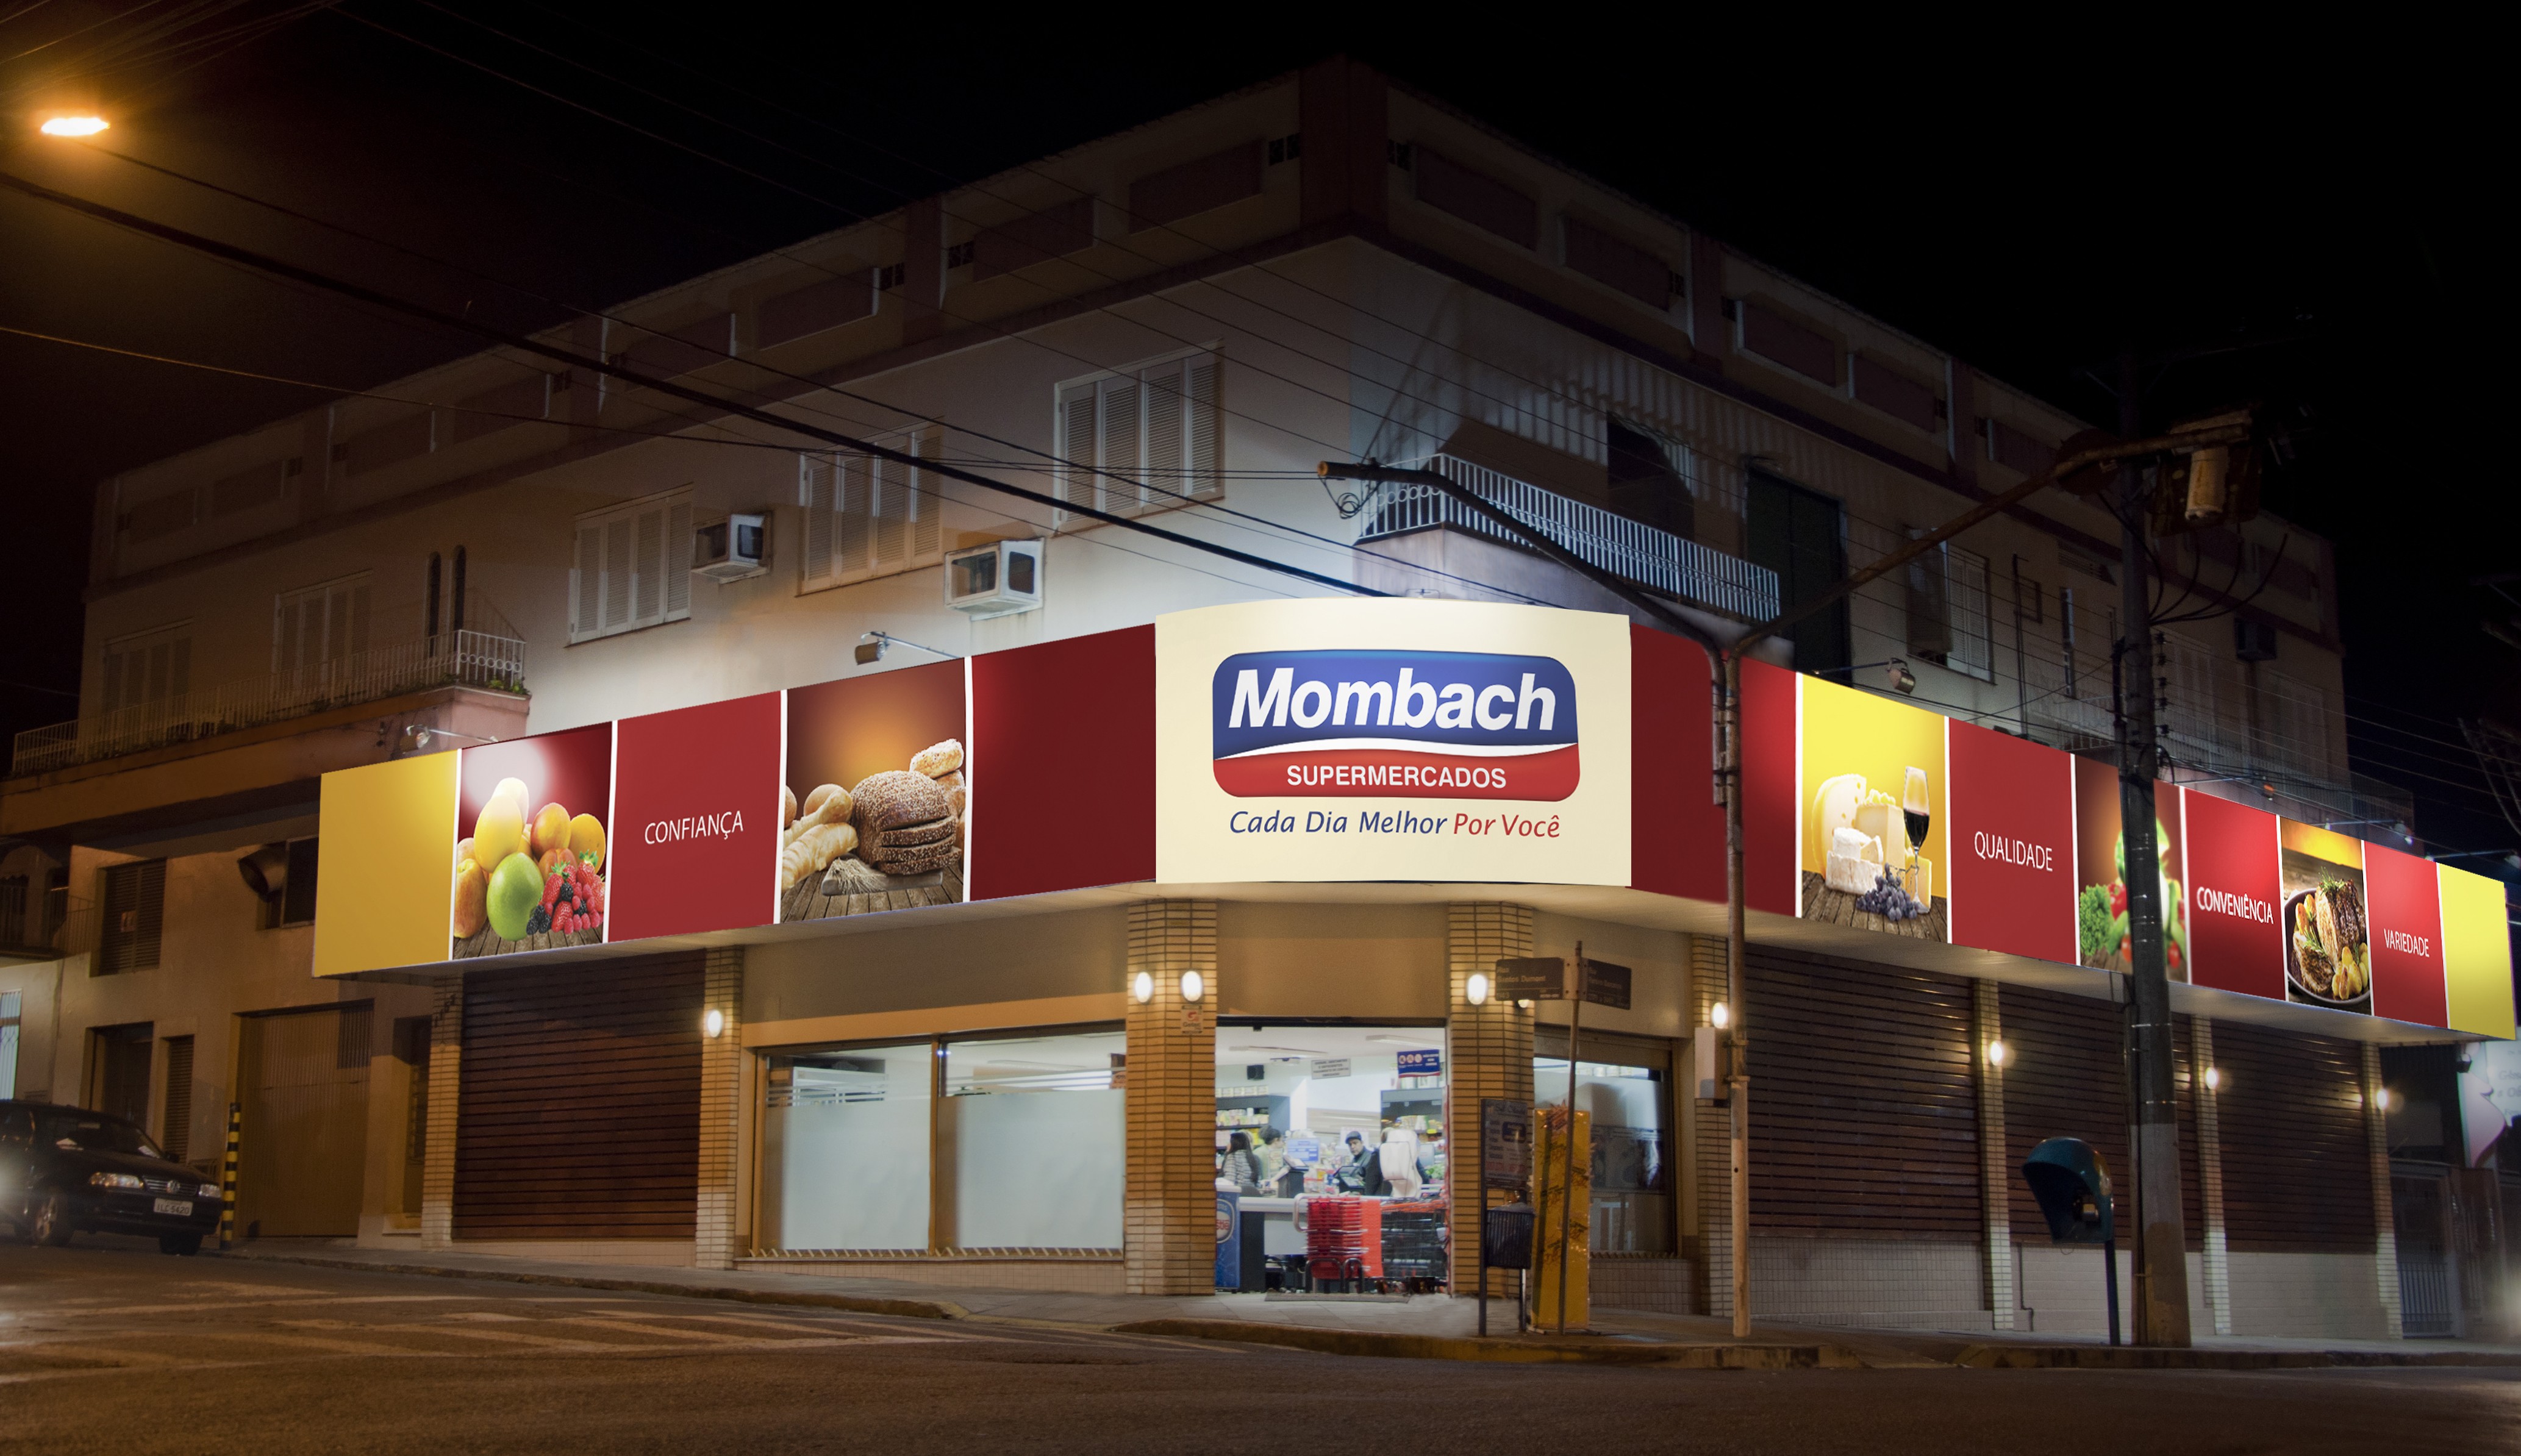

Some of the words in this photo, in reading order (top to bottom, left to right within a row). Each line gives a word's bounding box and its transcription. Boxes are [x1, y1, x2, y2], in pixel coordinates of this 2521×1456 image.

[1228, 668, 1556, 731] Mombach
[1287, 765, 1506, 789] SUPERMERCADOS
[645, 810, 744, 844] CONFIANÇA
[1230, 810, 1295, 833] Cada
[1305, 811, 1348, 833] Dia
[1359, 811, 1448, 834] Melhor
[1454, 813, 1498, 836] Por
[1501, 815, 1561, 838] Você
[1974, 831, 2053, 871] QUALIDADE
[2197, 886, 2274, 924] CONVENIÊNCIA
[2383, 927, 2430, 958] VARIEDADE
